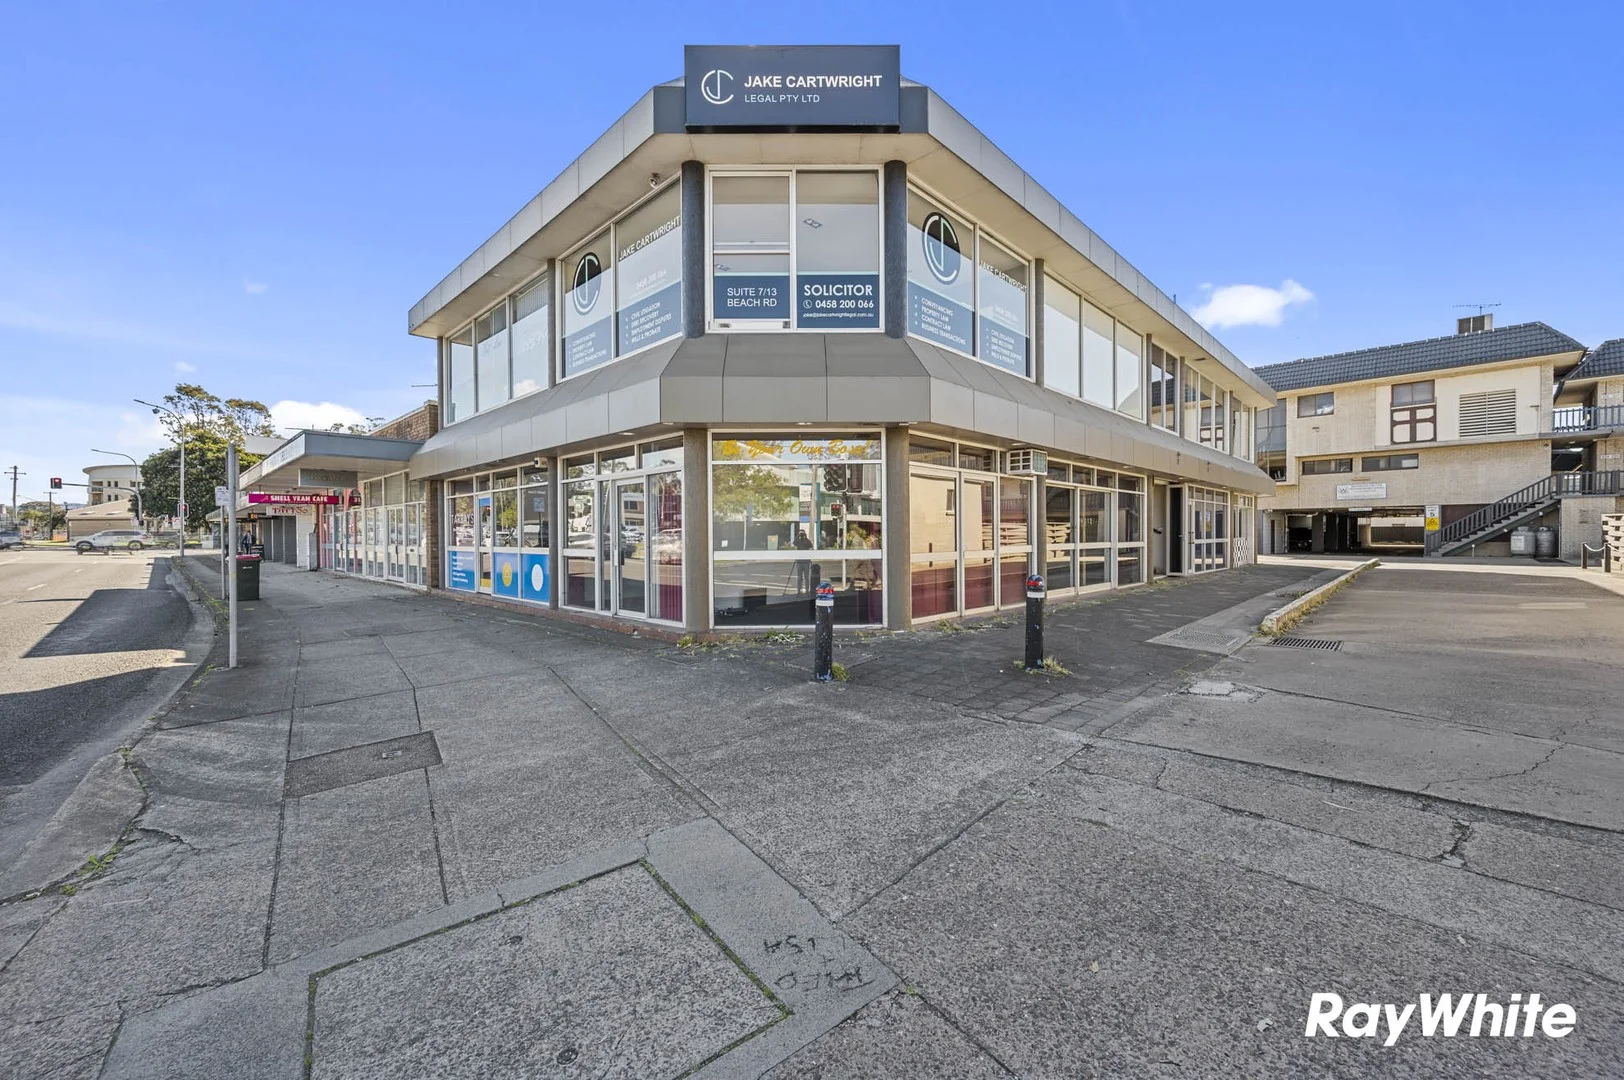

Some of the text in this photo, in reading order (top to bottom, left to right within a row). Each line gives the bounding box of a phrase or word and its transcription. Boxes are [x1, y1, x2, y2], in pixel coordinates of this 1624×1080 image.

[744, 75, 883, 88] JAKE CARTWRIGHT
[744, 94, 820, 103] LEGAL PTY LTD
[619, 215, 681, 261] JAKE CARTWRIGHT
[727, 287, 778, 296] SUITE 7/13
[803, 284, 873, 297] SOLICITOR
[727, 298, 777, 307] BEACH RD
[815, 300, 874, 309] 0458 200 066
[790, 439, 823, 455] Own
